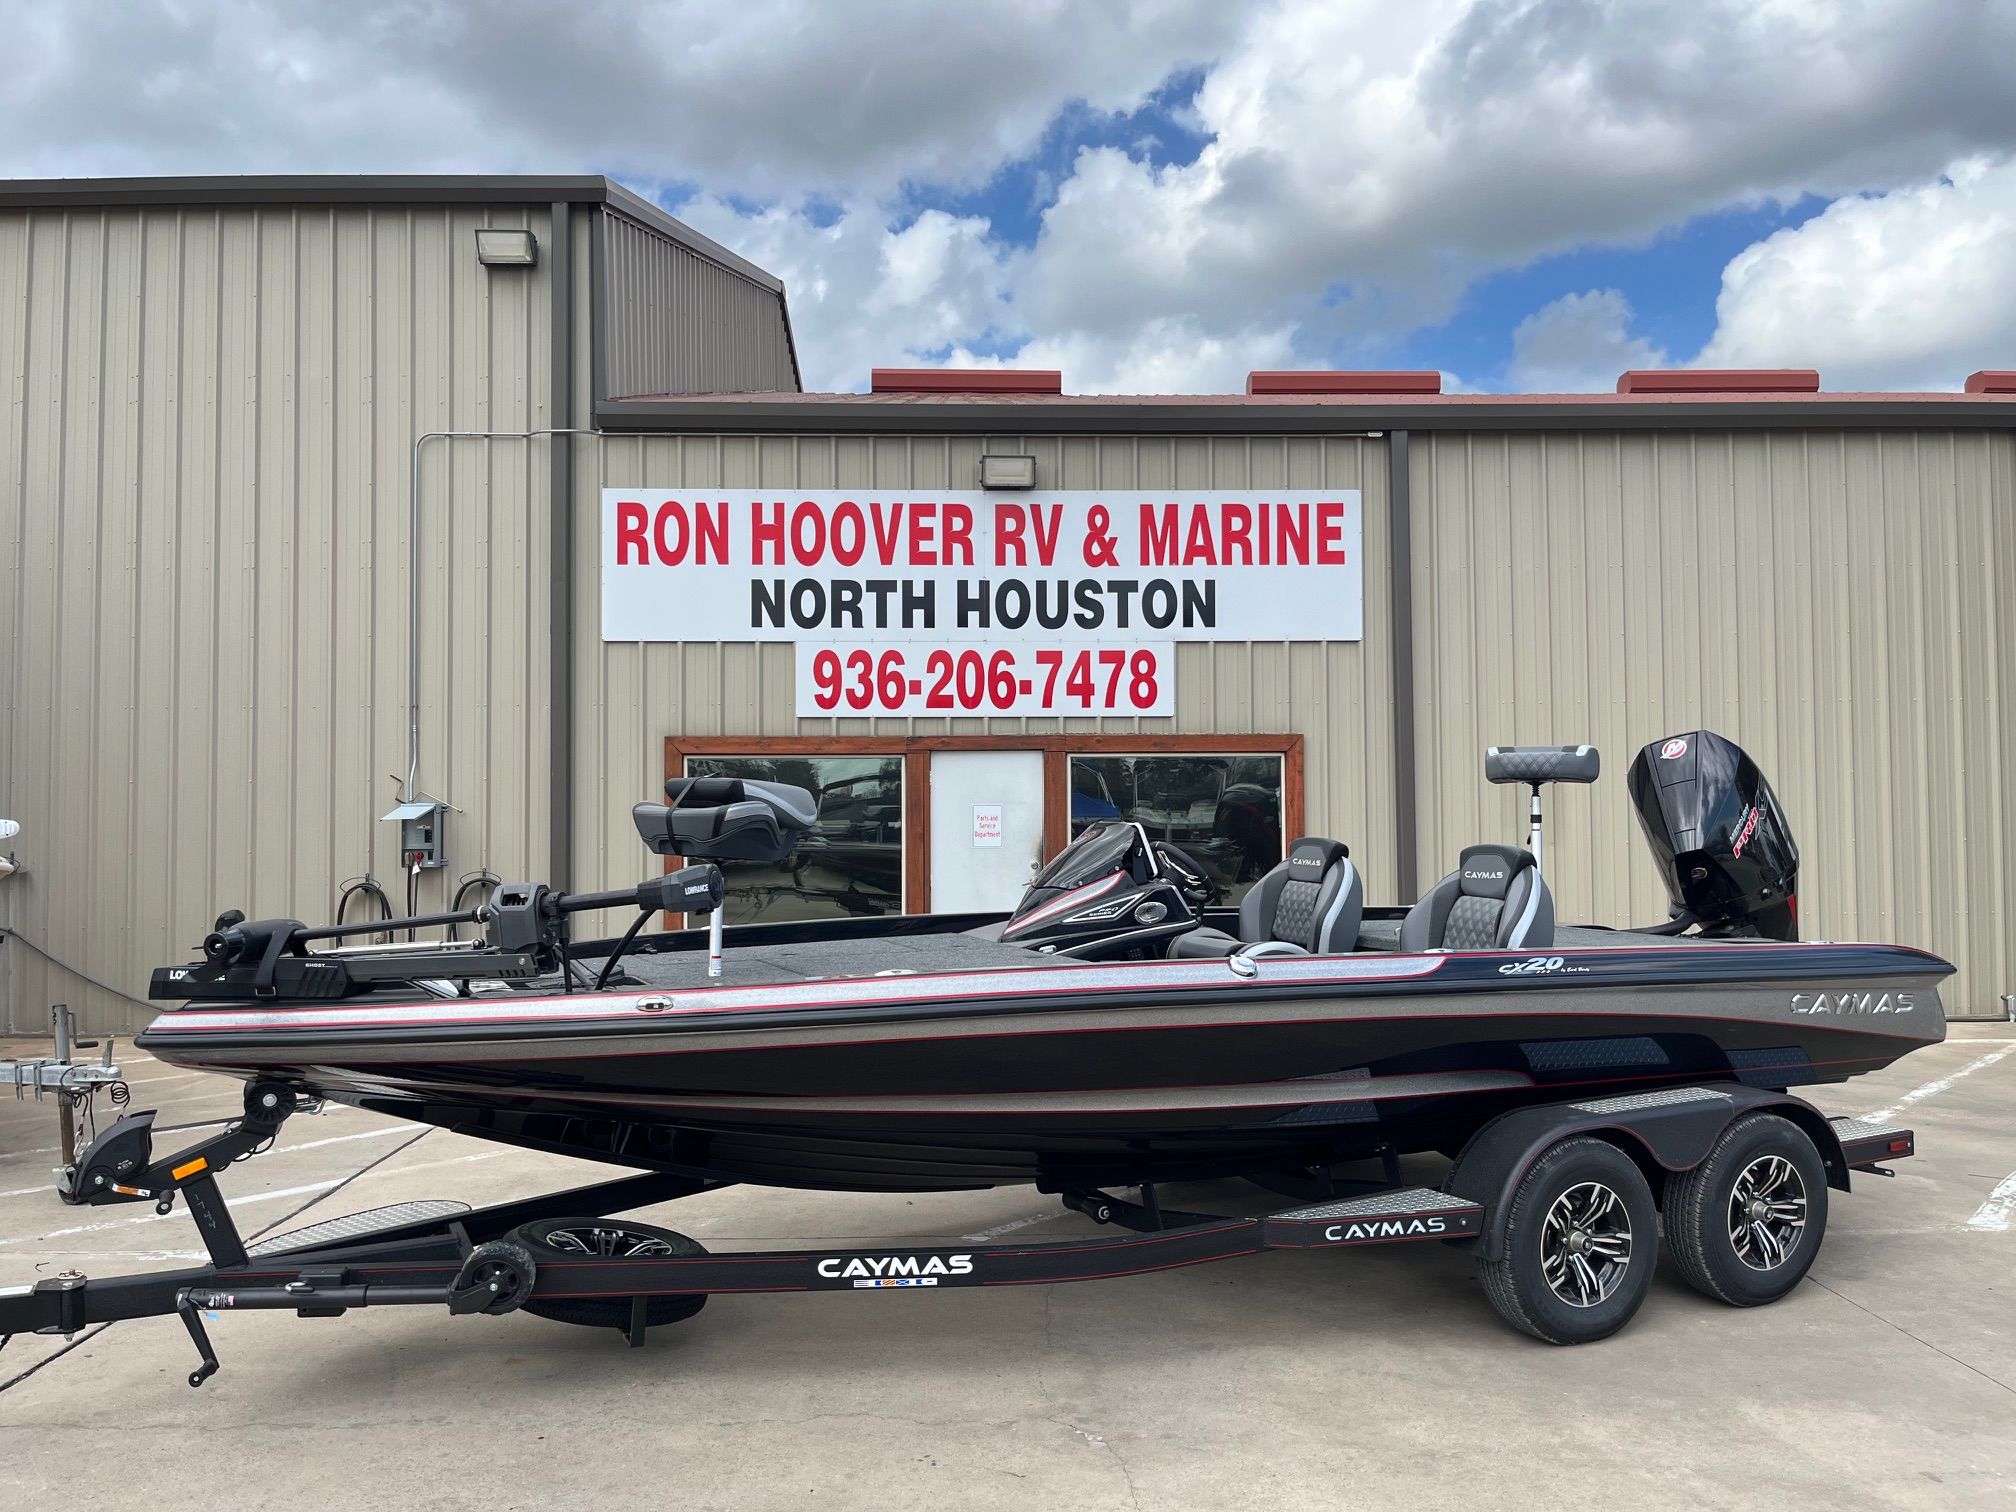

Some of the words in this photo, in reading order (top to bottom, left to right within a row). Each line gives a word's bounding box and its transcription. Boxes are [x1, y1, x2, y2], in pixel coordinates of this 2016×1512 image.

[616, 501, 730, 568] RON
[751, 501, 974, 567] HOOVER
[995, 503, 1064, 567] RV
[1083, 504, 1120, 568] &
[1139, 502, 1346, 567] MARINE
[751, 578, 936, 630] NORTH
[956, 578, 1216, 630] HOUSTON
[812, 648, 1159, 710] 936-206-7478
[1730, 803, 1749, 844] MERCURY
[1292, 857, 1321, 866] CAYMAS
[1464, 870, 1504, 879] CAYMAS
[684, 883, 709, 896] LOWRANCE
[1790, 992, 1915, 1015] CAYMAS
[1324, 1217, 1447, 1241] CAYMAS
[817, 1254, 974, 1278] CAYMAS
